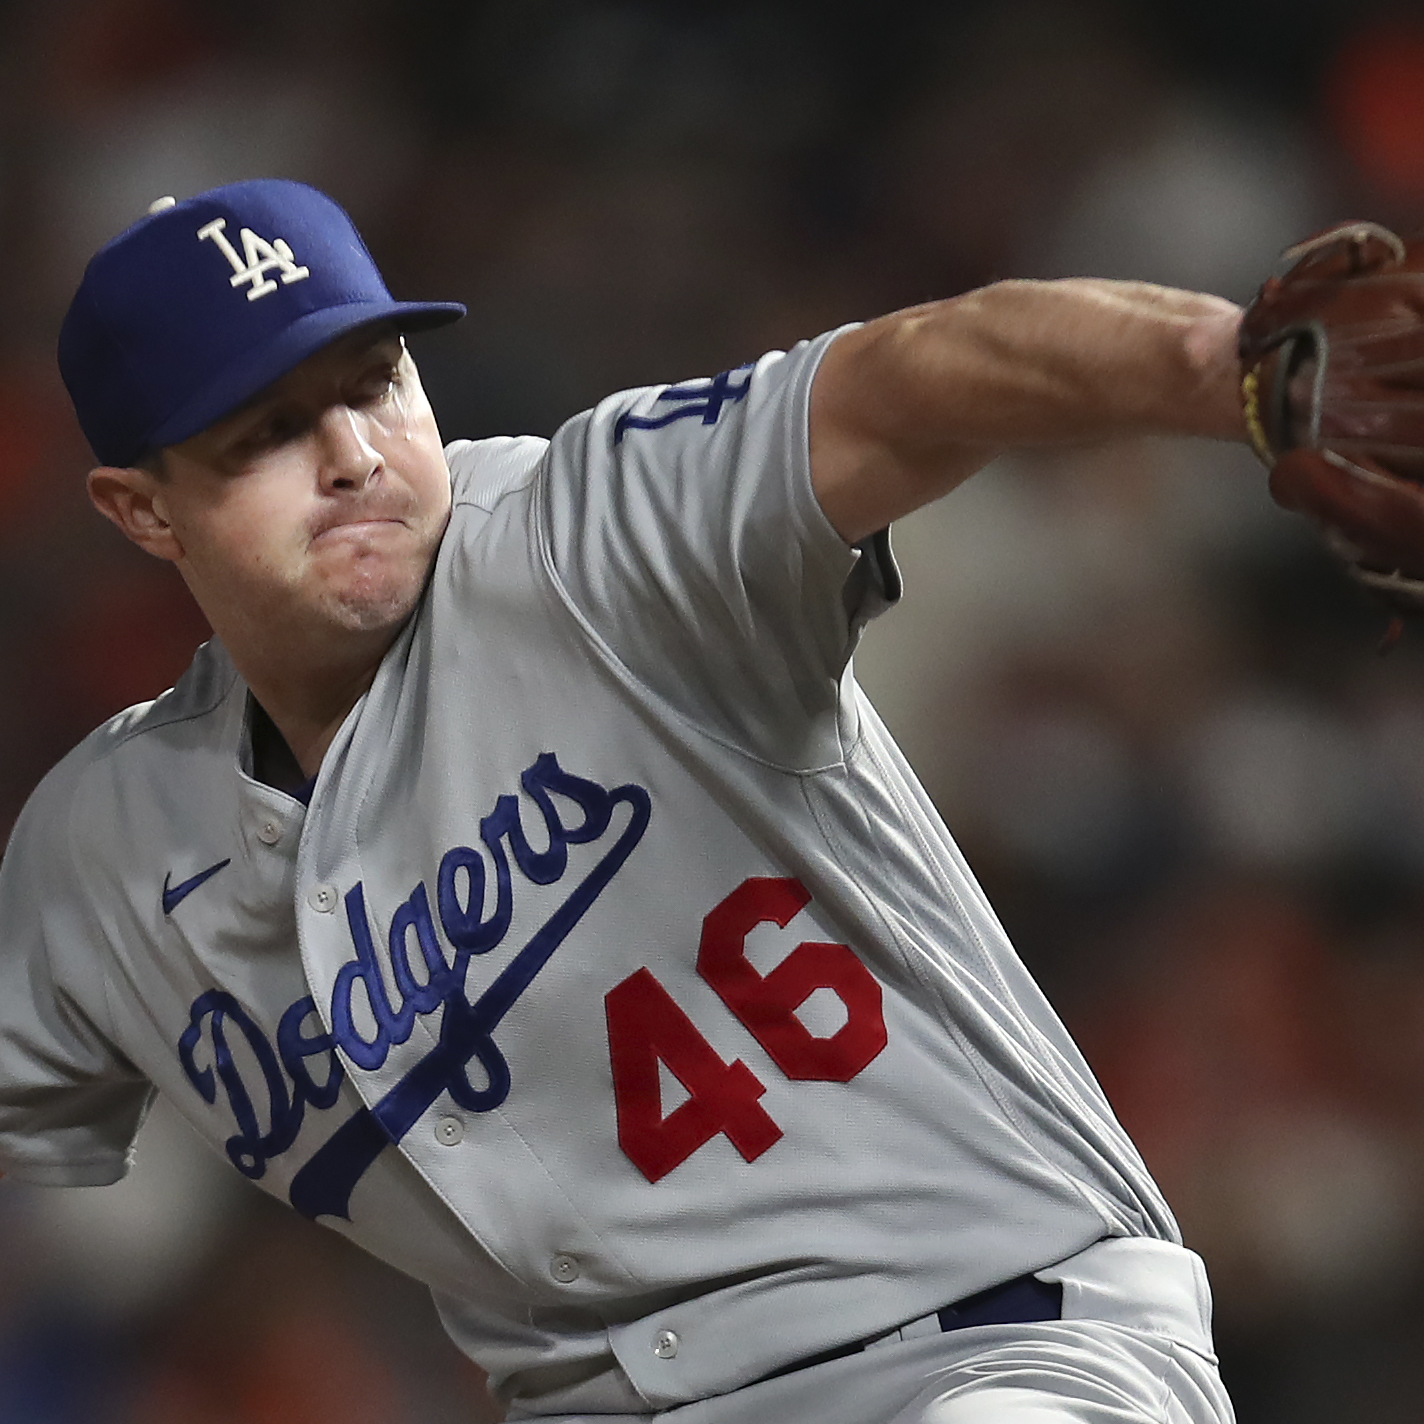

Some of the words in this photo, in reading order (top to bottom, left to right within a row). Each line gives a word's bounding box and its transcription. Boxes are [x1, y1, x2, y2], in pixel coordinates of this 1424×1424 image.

[196, 217, 310, 302] LA
[179, 752, 652, 1222] Dodgers
[604, 876, 888, 1184] 46
